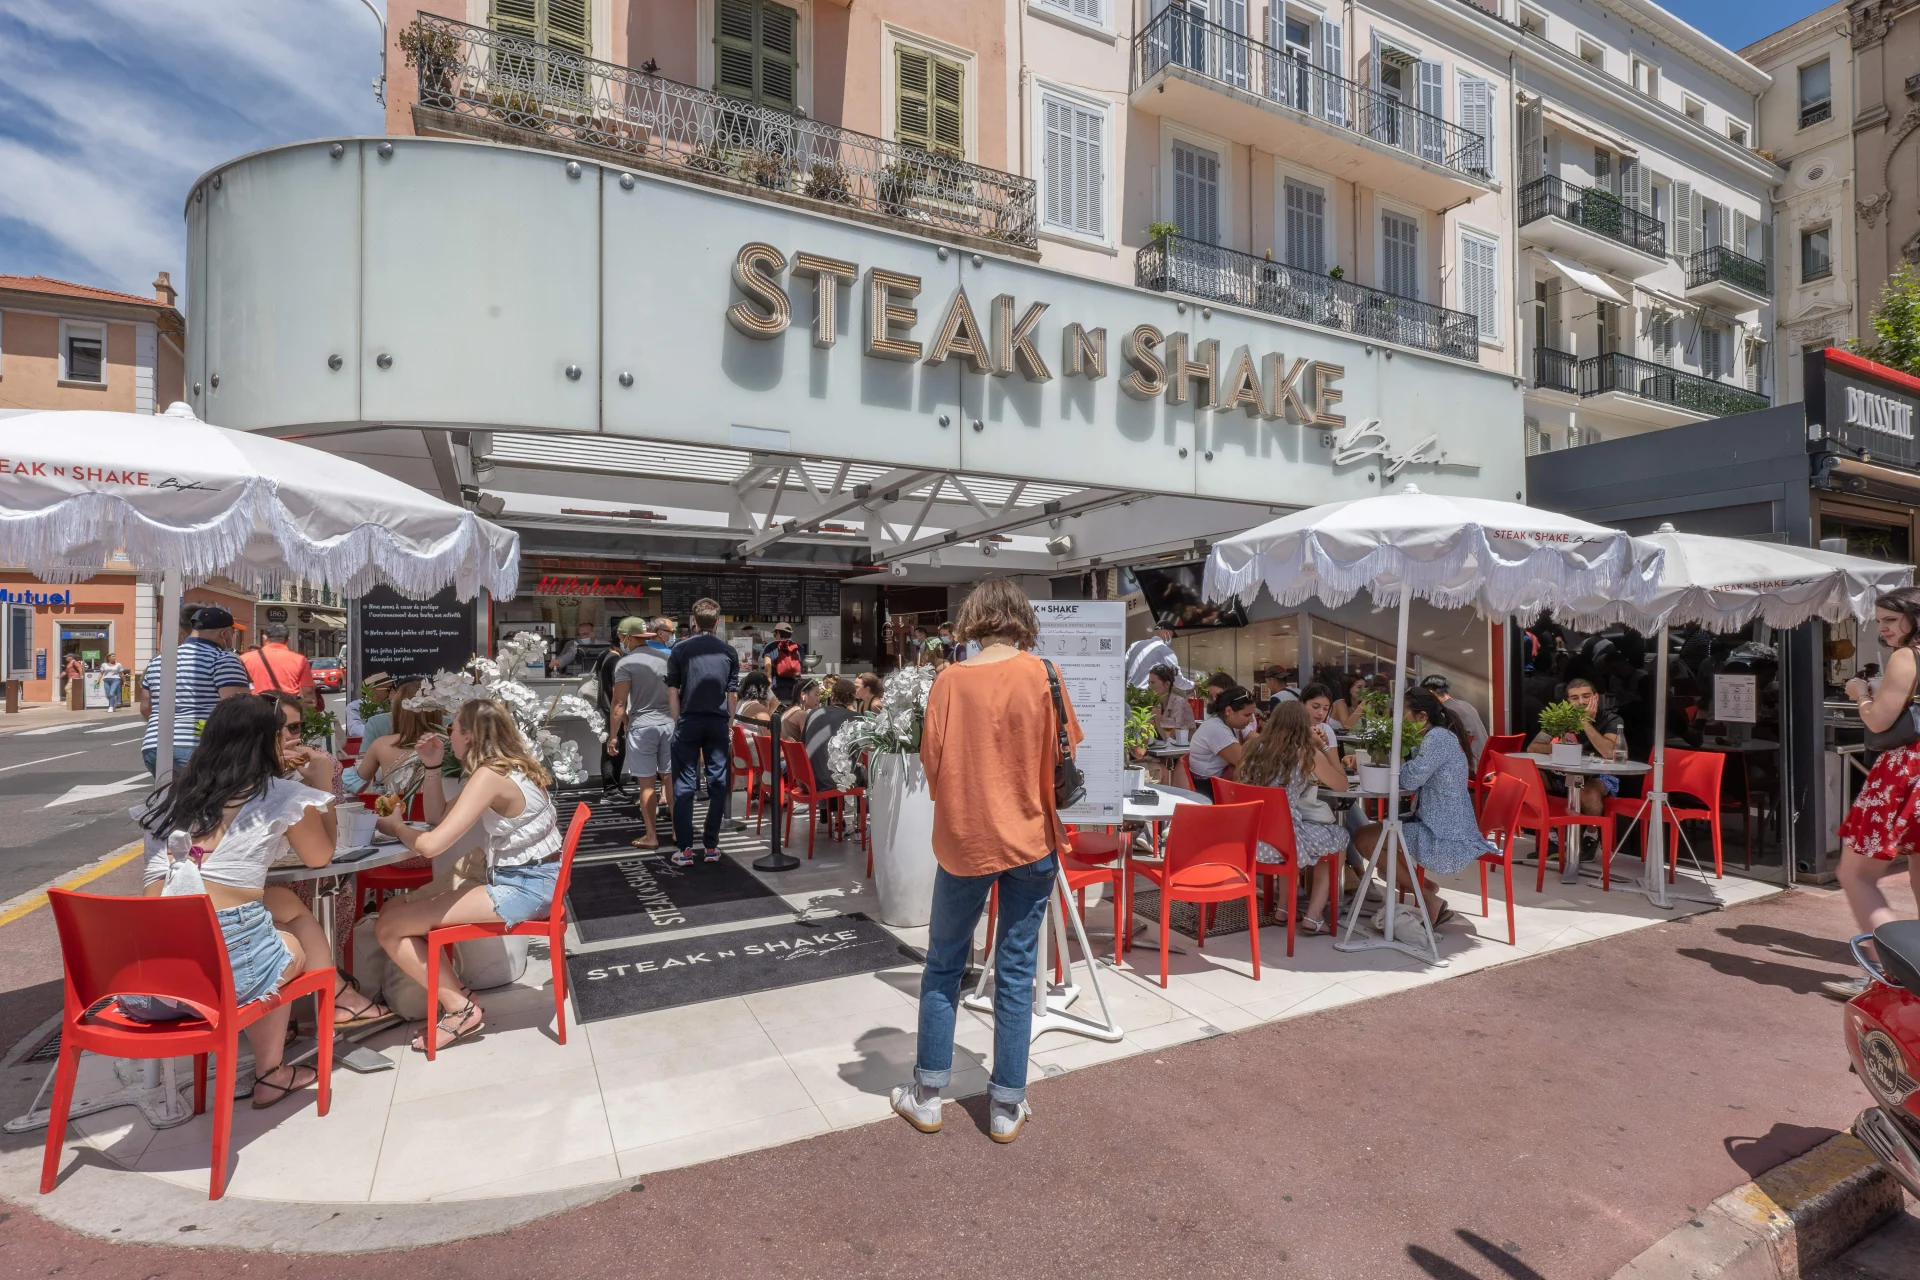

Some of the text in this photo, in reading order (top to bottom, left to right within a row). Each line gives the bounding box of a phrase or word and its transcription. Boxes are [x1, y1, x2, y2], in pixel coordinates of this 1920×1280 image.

[725, 241, 1347, 430] STEAK N SHAKE
[1844, 386, 1914, 440] BRASSERIE
[53, 466, 65, 477] N
[72, 466, 149, 487] SHAKE
[1493, 529, 1526, 540] STEAK
[1534, 532, 1570, 543] SHAKE
[534, 575, 644, 597] Milkshakes
[1713, 582, 1743, 593] STEAK
[1752, 579, 1787, 589] SHAKE
[1047, 605, 1078, 613] SHAKE
[616, 860, 658, 887] SHAKE
[637, 892, 686, 925] STEAK
[587, 930, 858, 980] STEAK N SHAKE
[1870, 1041, 1895, 1072] Steak
[1868, 1057, 1895, 1090] Shake
